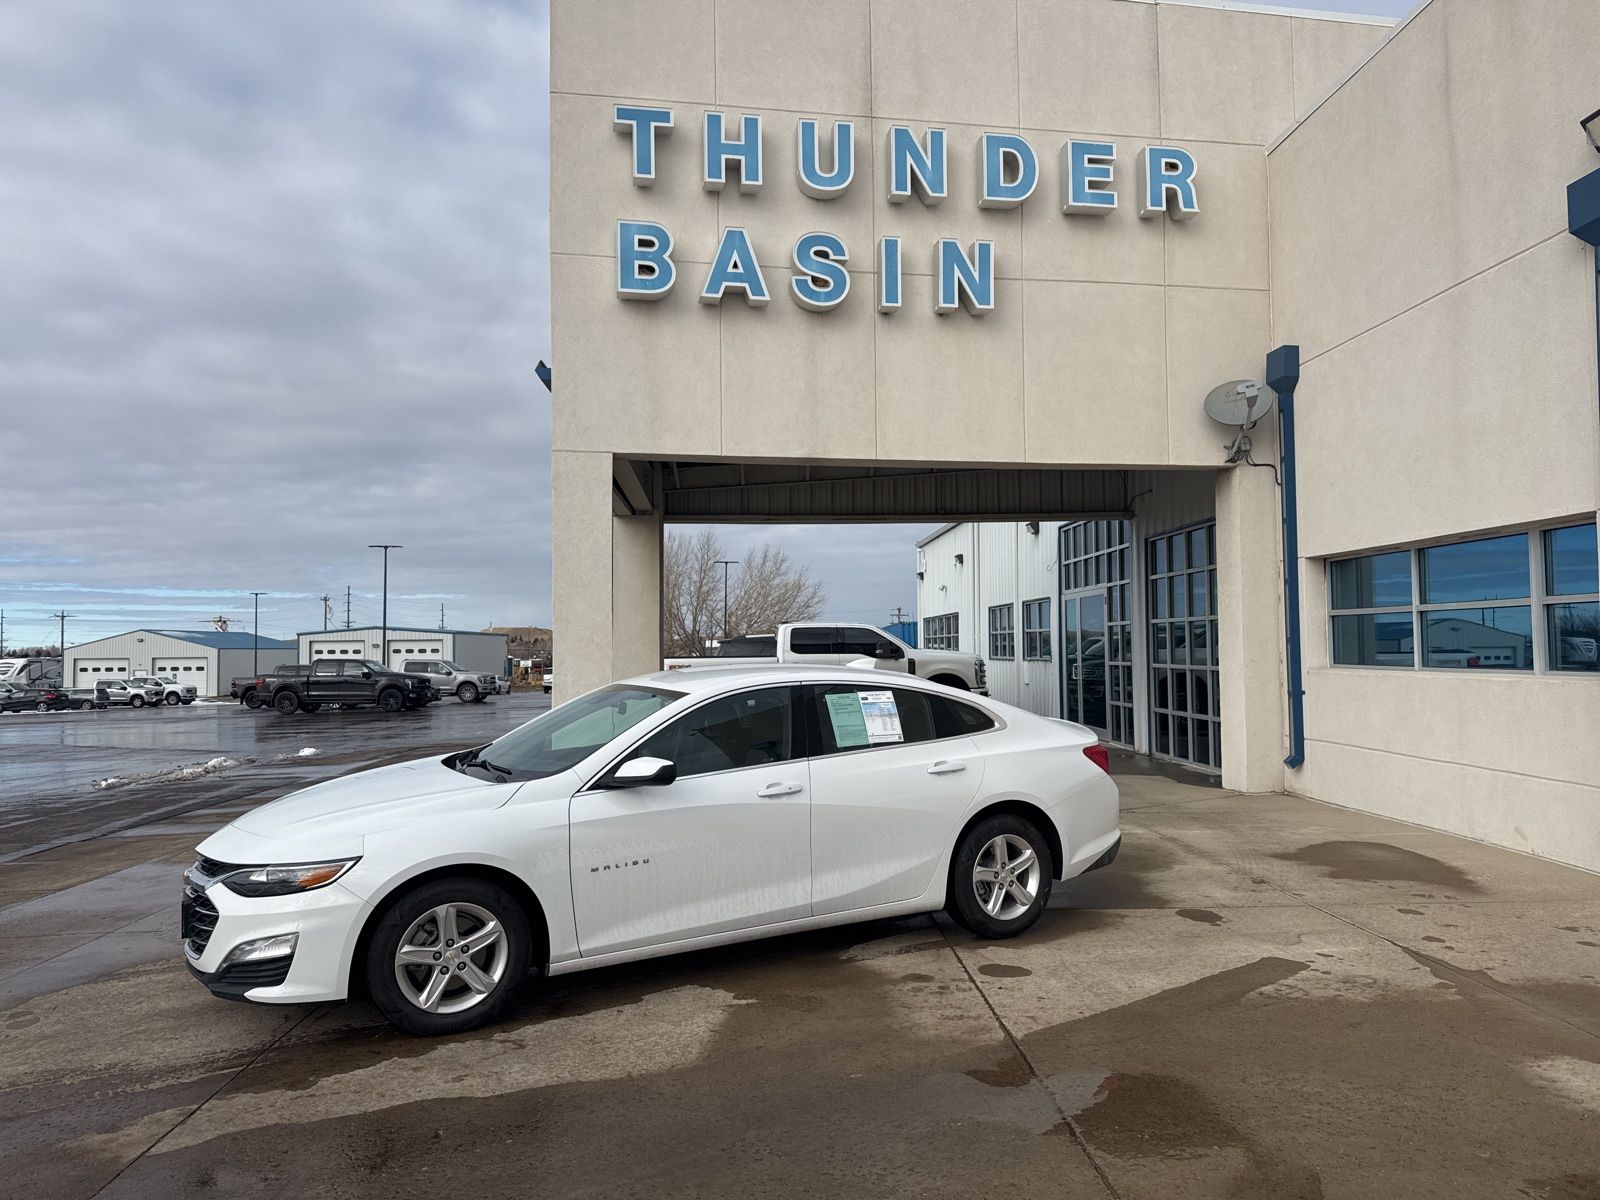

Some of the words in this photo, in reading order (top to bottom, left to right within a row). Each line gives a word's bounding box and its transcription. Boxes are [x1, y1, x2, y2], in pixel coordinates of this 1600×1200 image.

[613, 104, 1201, 218] THUNDER
[616, 219, 995, 313] BASIN
[590, 858, 650, 872] MALIBU
